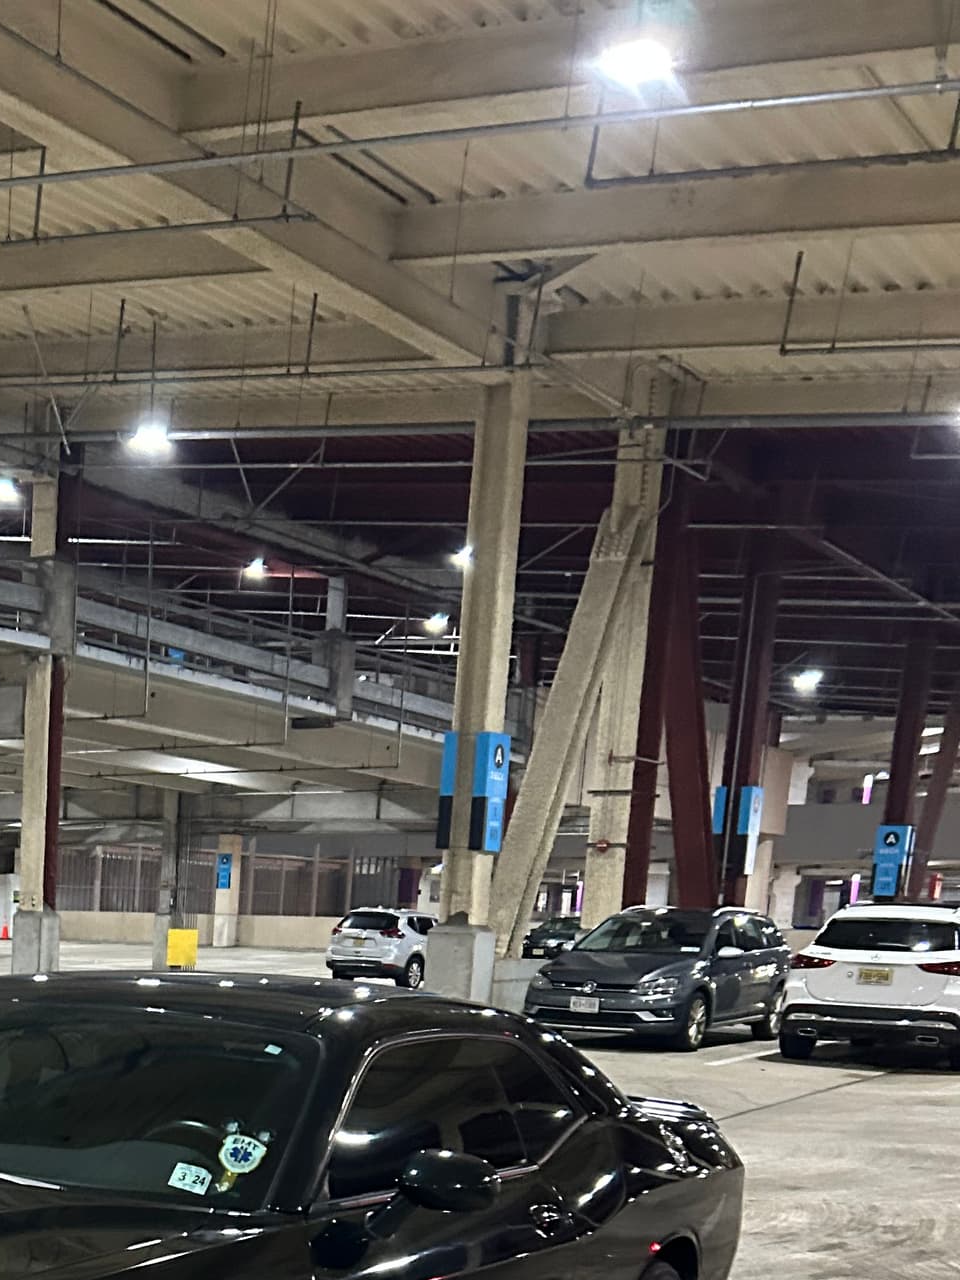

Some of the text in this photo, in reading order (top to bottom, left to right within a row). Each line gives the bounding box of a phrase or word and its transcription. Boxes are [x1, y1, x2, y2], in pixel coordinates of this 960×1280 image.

[495, 746, 504, 765] A
[886, 834, 897, 844] A
[233, 1137, 259, 1151] EMT
[178, 1171, 187, 1182] 3
[191, 1174, 207, 1187] 24
